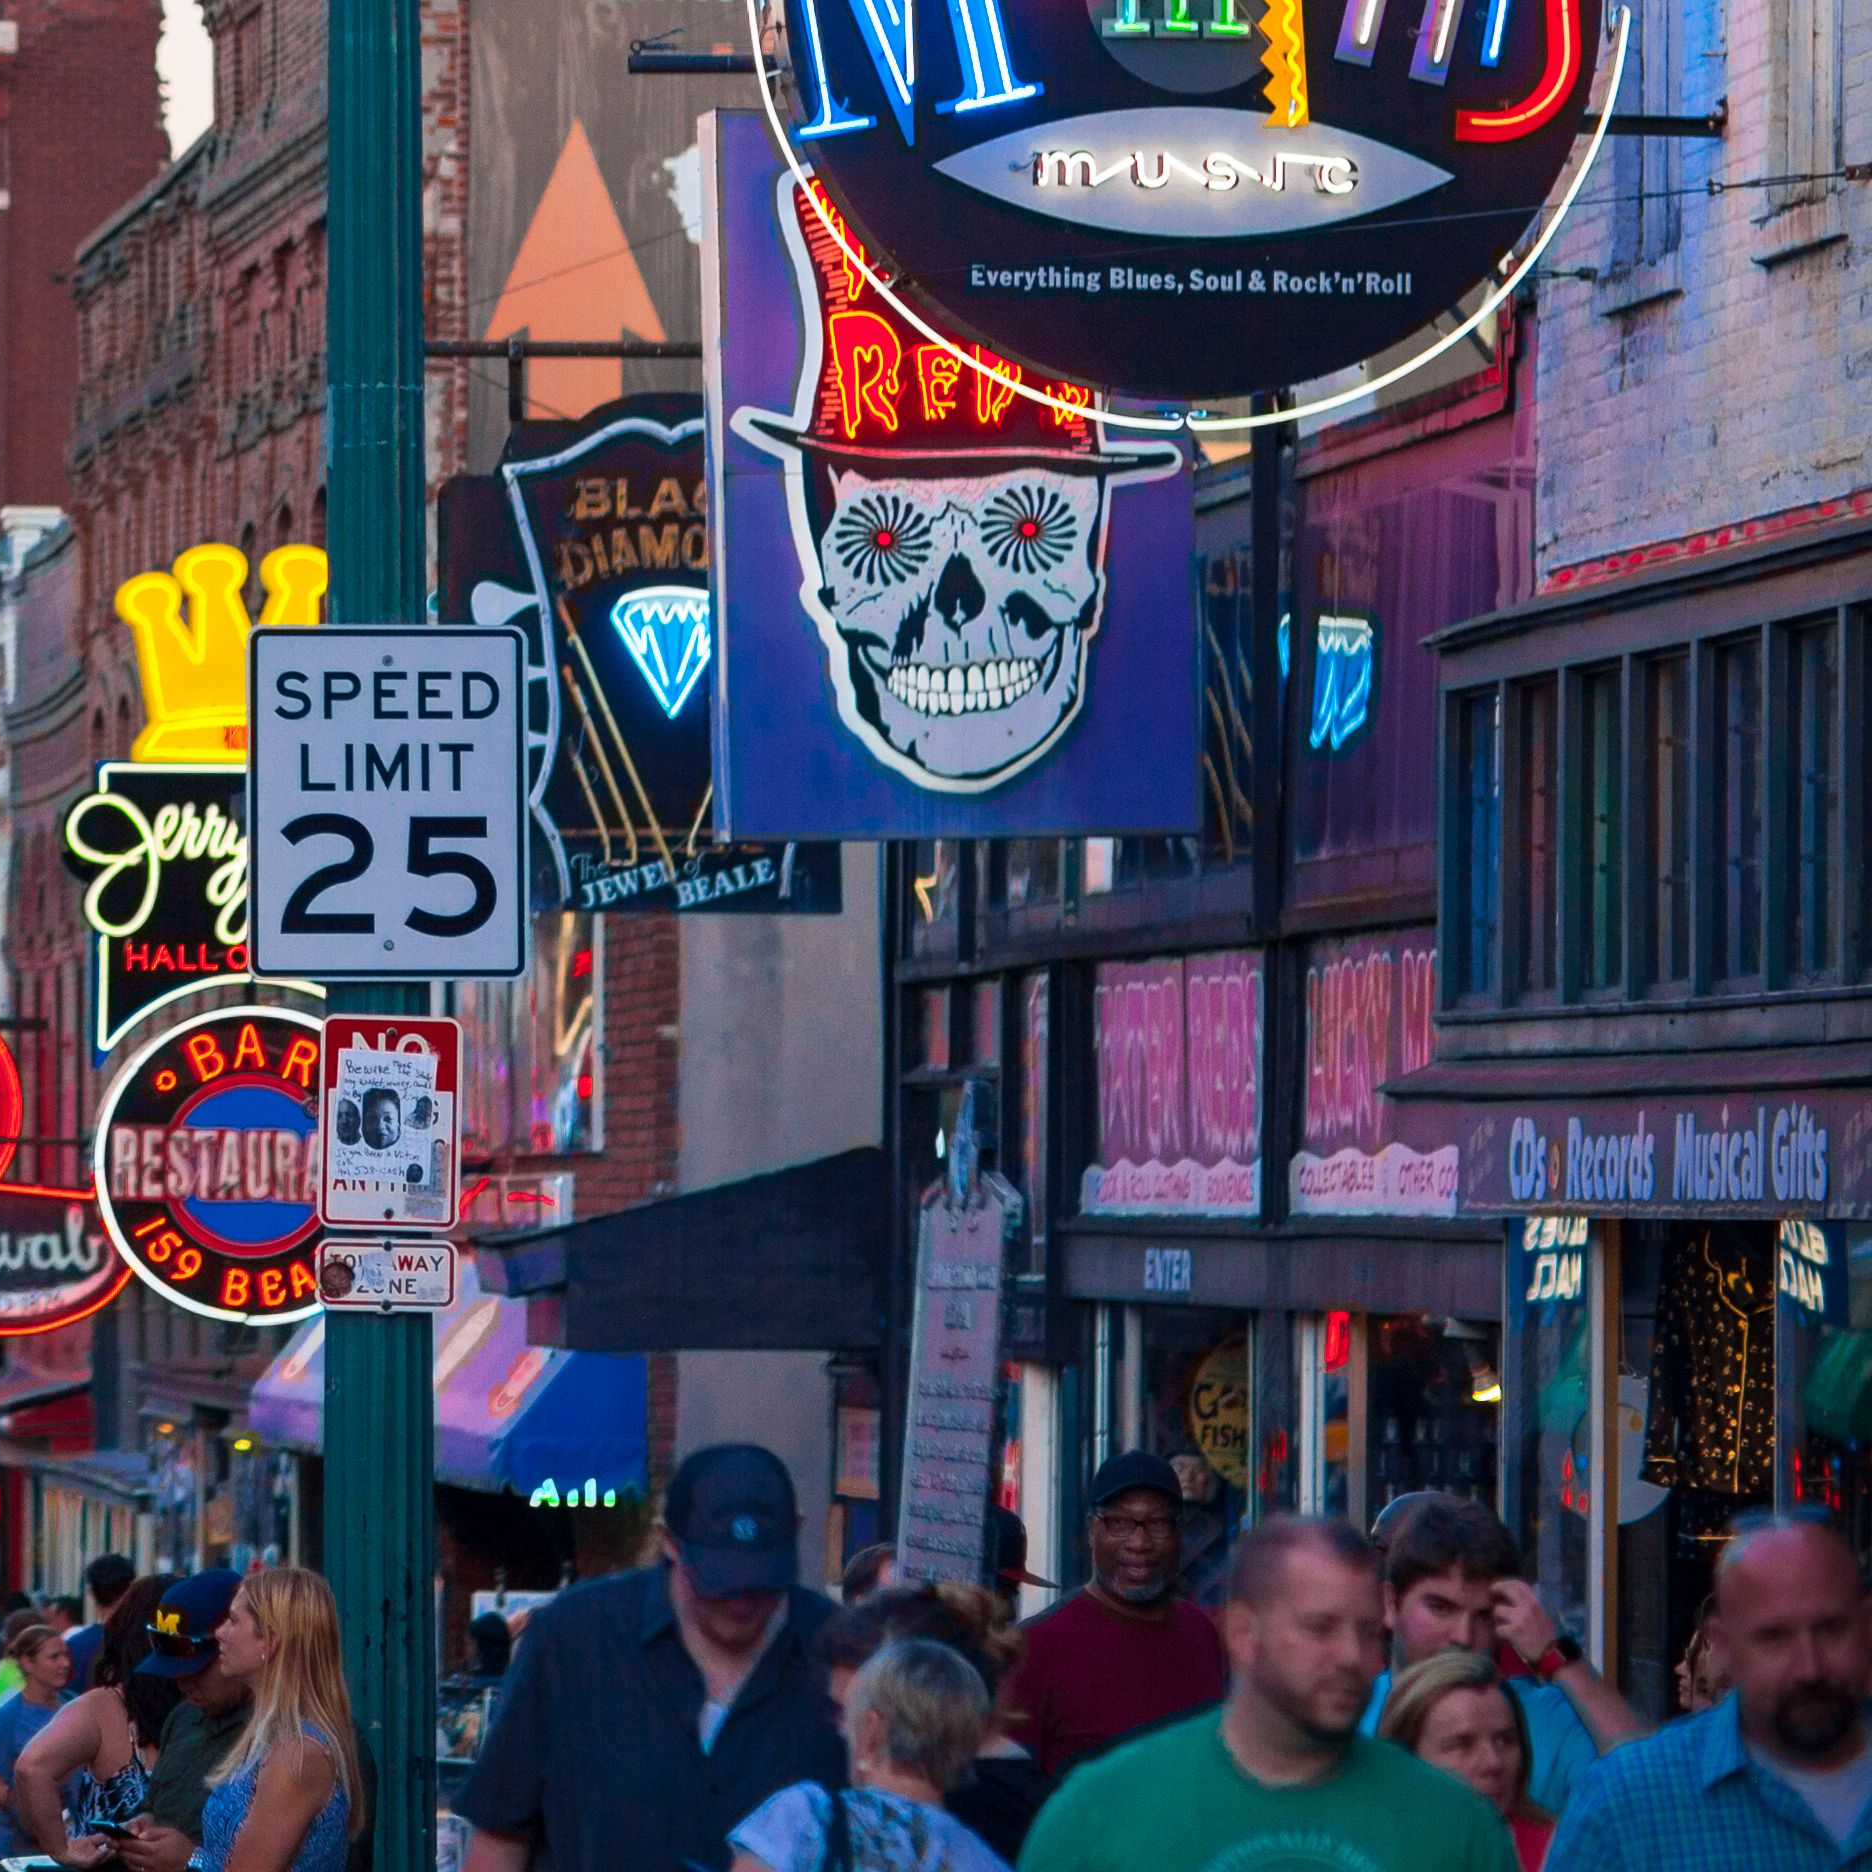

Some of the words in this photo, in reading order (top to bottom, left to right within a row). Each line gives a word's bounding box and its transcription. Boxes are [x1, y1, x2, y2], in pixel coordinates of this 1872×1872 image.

[1034, 151, 1357, 195] music
[970, 264, 1101, 291] Everything
[1109, 267, 1184, 295] Blues,
[1189, 269, 1242, 291] Soul
[1247, 270, 1266, 292] &
[1272, 270, 1412, 296] Rock'n'Roll
[274, 671, 501, 720] SPEED
[300, 743, 476, 792] LIMIT
[279, 813, 498, 936] 25
[673, 857, 777, 909] BEALE
[124, 943, 220, 972] HALL
[187, 1023, 318, 1088] BAR
[1509, 1115, 1547, 1201] CDs
[1566, 1109, 1655, 1201] Records
[1672, 1102, 1767, 1202] Musical
[1771, 1101, 1829, 1202] Gifts
[133, 1217, 203, 1281] 159
[1143, 1247, 1193, 1293] ENTER
[222, 1261, 319, 1308] BEA
[155, 1609, 181, 1636] M
